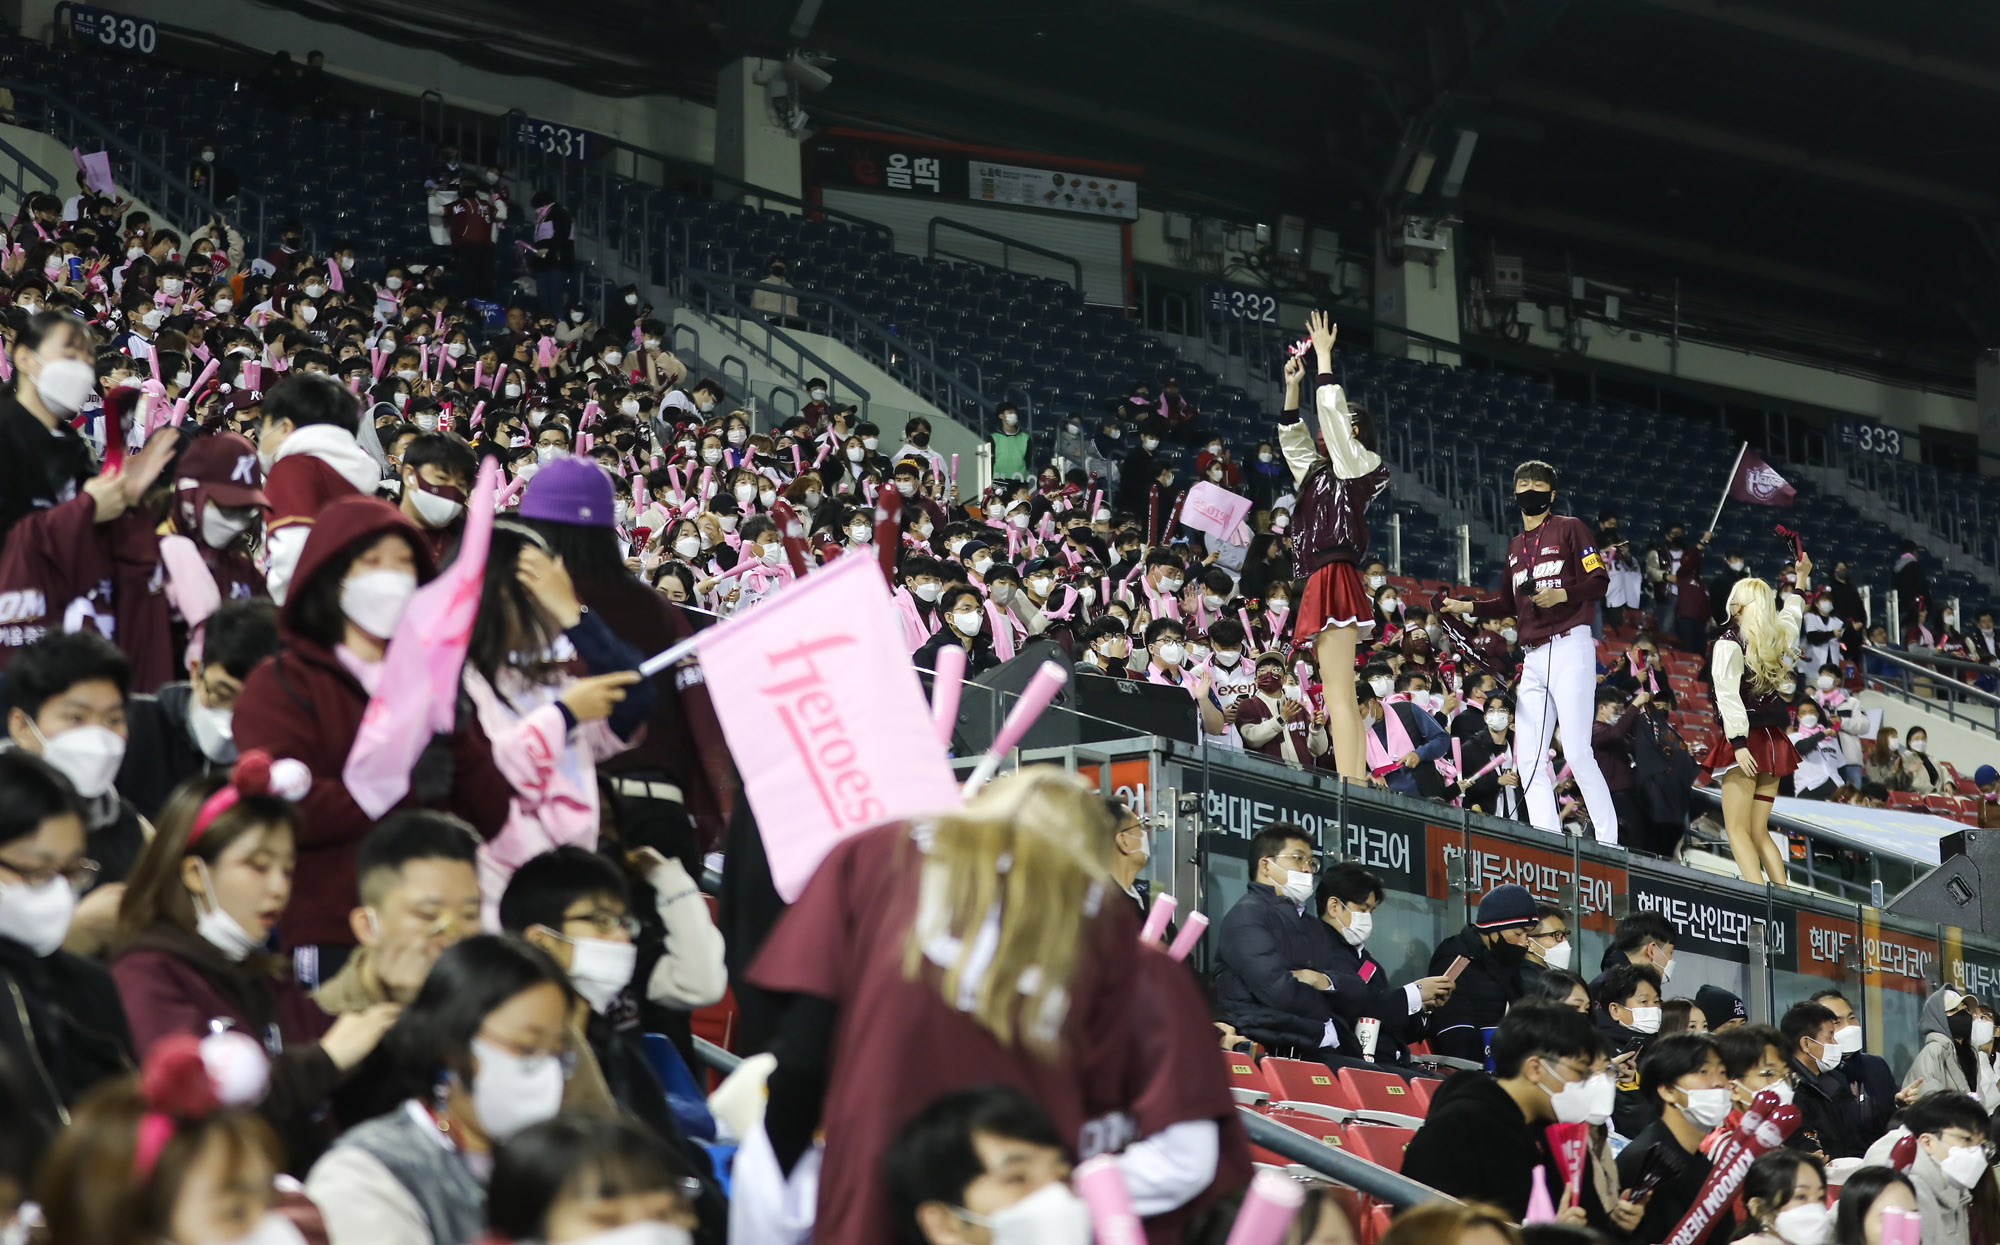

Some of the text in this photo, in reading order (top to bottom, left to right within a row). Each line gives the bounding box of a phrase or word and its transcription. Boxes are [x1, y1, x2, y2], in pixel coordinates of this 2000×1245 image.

[99, 14, 156, 54] 330
[540, 124, 585, 161] 331
[886, 153, 940, 193] 올떡
[1231, 291, 1276, 323] 332
[1860, 425, 1900, 455] 333
[1216, 681, 1257, 698] exen
[759, 634, 887, 826] Heroes
[1703, 1148, 1756, 1216] KIWOOM
